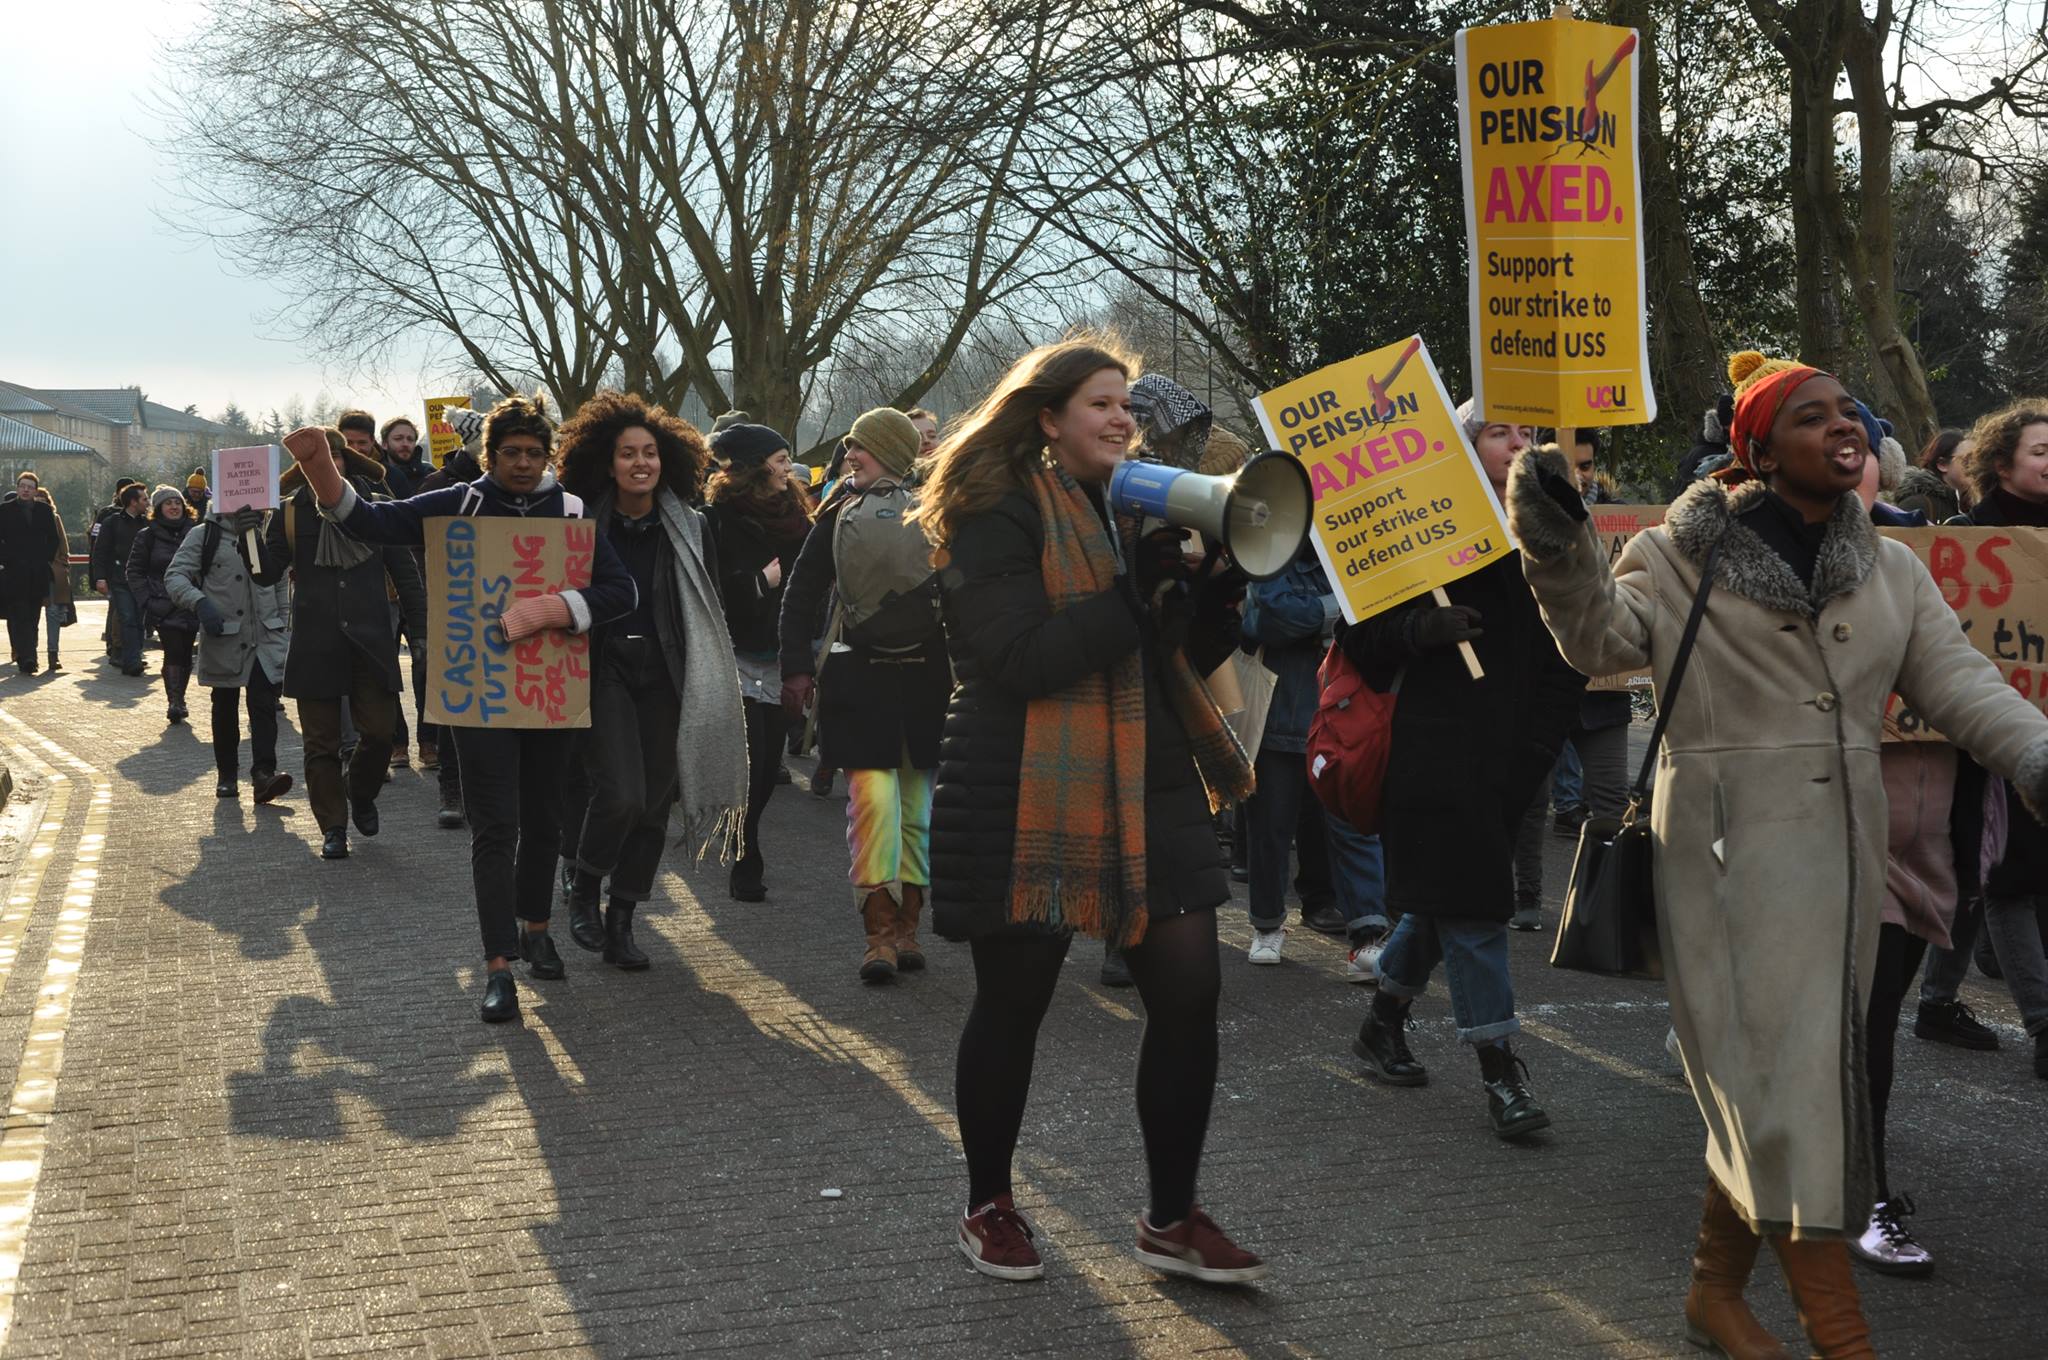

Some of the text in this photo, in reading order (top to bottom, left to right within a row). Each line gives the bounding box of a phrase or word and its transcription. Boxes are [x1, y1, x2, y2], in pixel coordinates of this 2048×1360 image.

[1479, 58, 1544, 97] OUR
[1480, 105, 1616, 148] PENSION
[1484, 164, 1624, 225] AXED.
[1487, 251, 1575, 287] Support
[1488, 290, 1612, 318] our strike to
[1490, 330, 1607, 358] defend USS
[1279, 390, 1341, 430] OUR
[1288, 391, 1420, 457] PENSION
[226, 469, 261, 479] RATHER
[1309, 427, 1446, 501] AXED.
[224, 486, 265, 497] TEACHING
[1324, 486, 1407, 531] Support
[1336, 496, 1453, 554] our strike to
[1345, 518, 1457, 577] defend USS
[441, 519, 476, 714] CASUALISED
[480, 574, 512, 723] TUTORS
